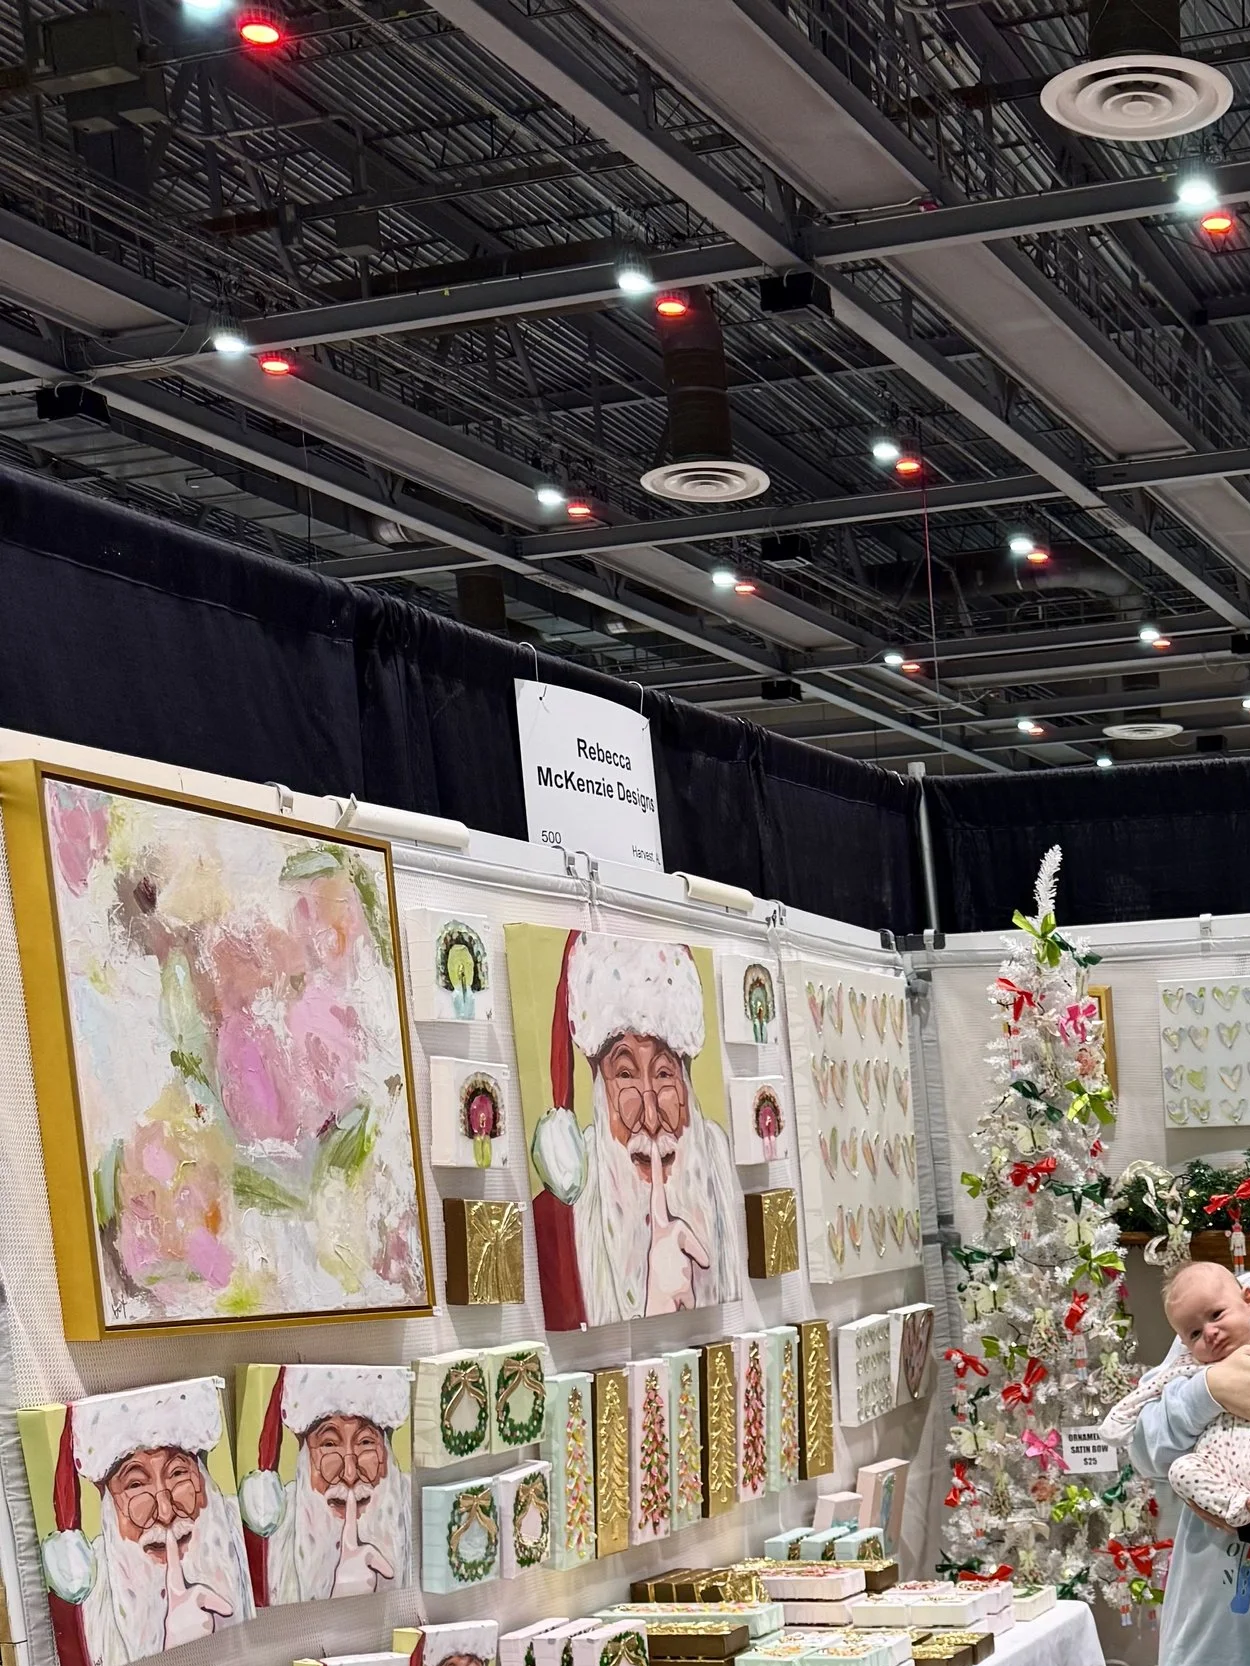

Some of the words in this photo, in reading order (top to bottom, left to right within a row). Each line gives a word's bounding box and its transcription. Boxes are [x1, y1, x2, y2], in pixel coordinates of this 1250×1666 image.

[576, 737, 632, 771] Rebecca
[537, 765, 614, 799] McKenzie
[617, 780, 655, 813] Designs
[541, 830, 562, 845] 500
[1070, 1445, 1091, 1454] SATIN
[1092, 1444, 1109, 1454] BOW
